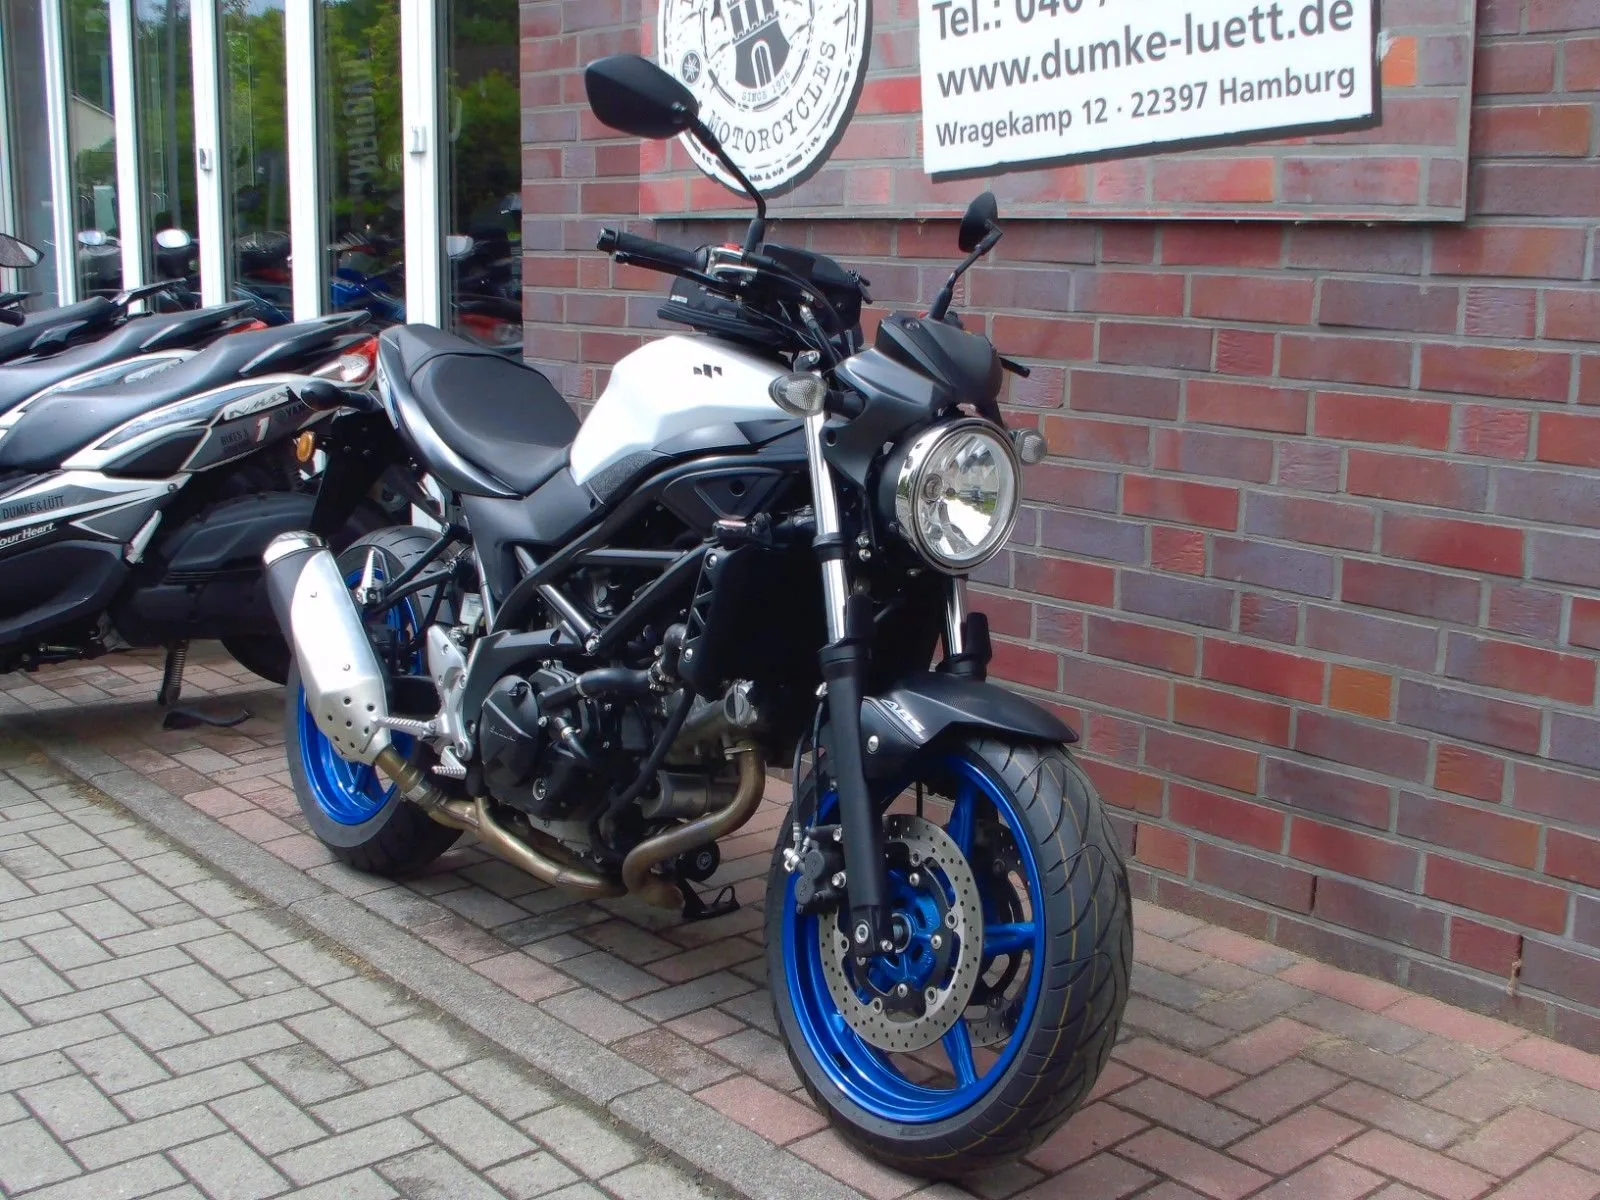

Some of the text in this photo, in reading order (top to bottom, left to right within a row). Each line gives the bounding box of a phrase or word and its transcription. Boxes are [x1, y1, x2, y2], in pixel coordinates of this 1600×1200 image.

[932, 0, 1001, 40] Tel.:
[937, 0, 1354, 98] www.dumke-luett.de
[707, 40, 836, 154] MOTORCYCLES
[936, 110, 1073, 148] Wragekamp
[1082, 97, 1108, 125] 12
[1131, 81, 1208, 118] 22397
[1219, 66, 1355, 106] Hamburg
[0, 532, 21, 546] our
